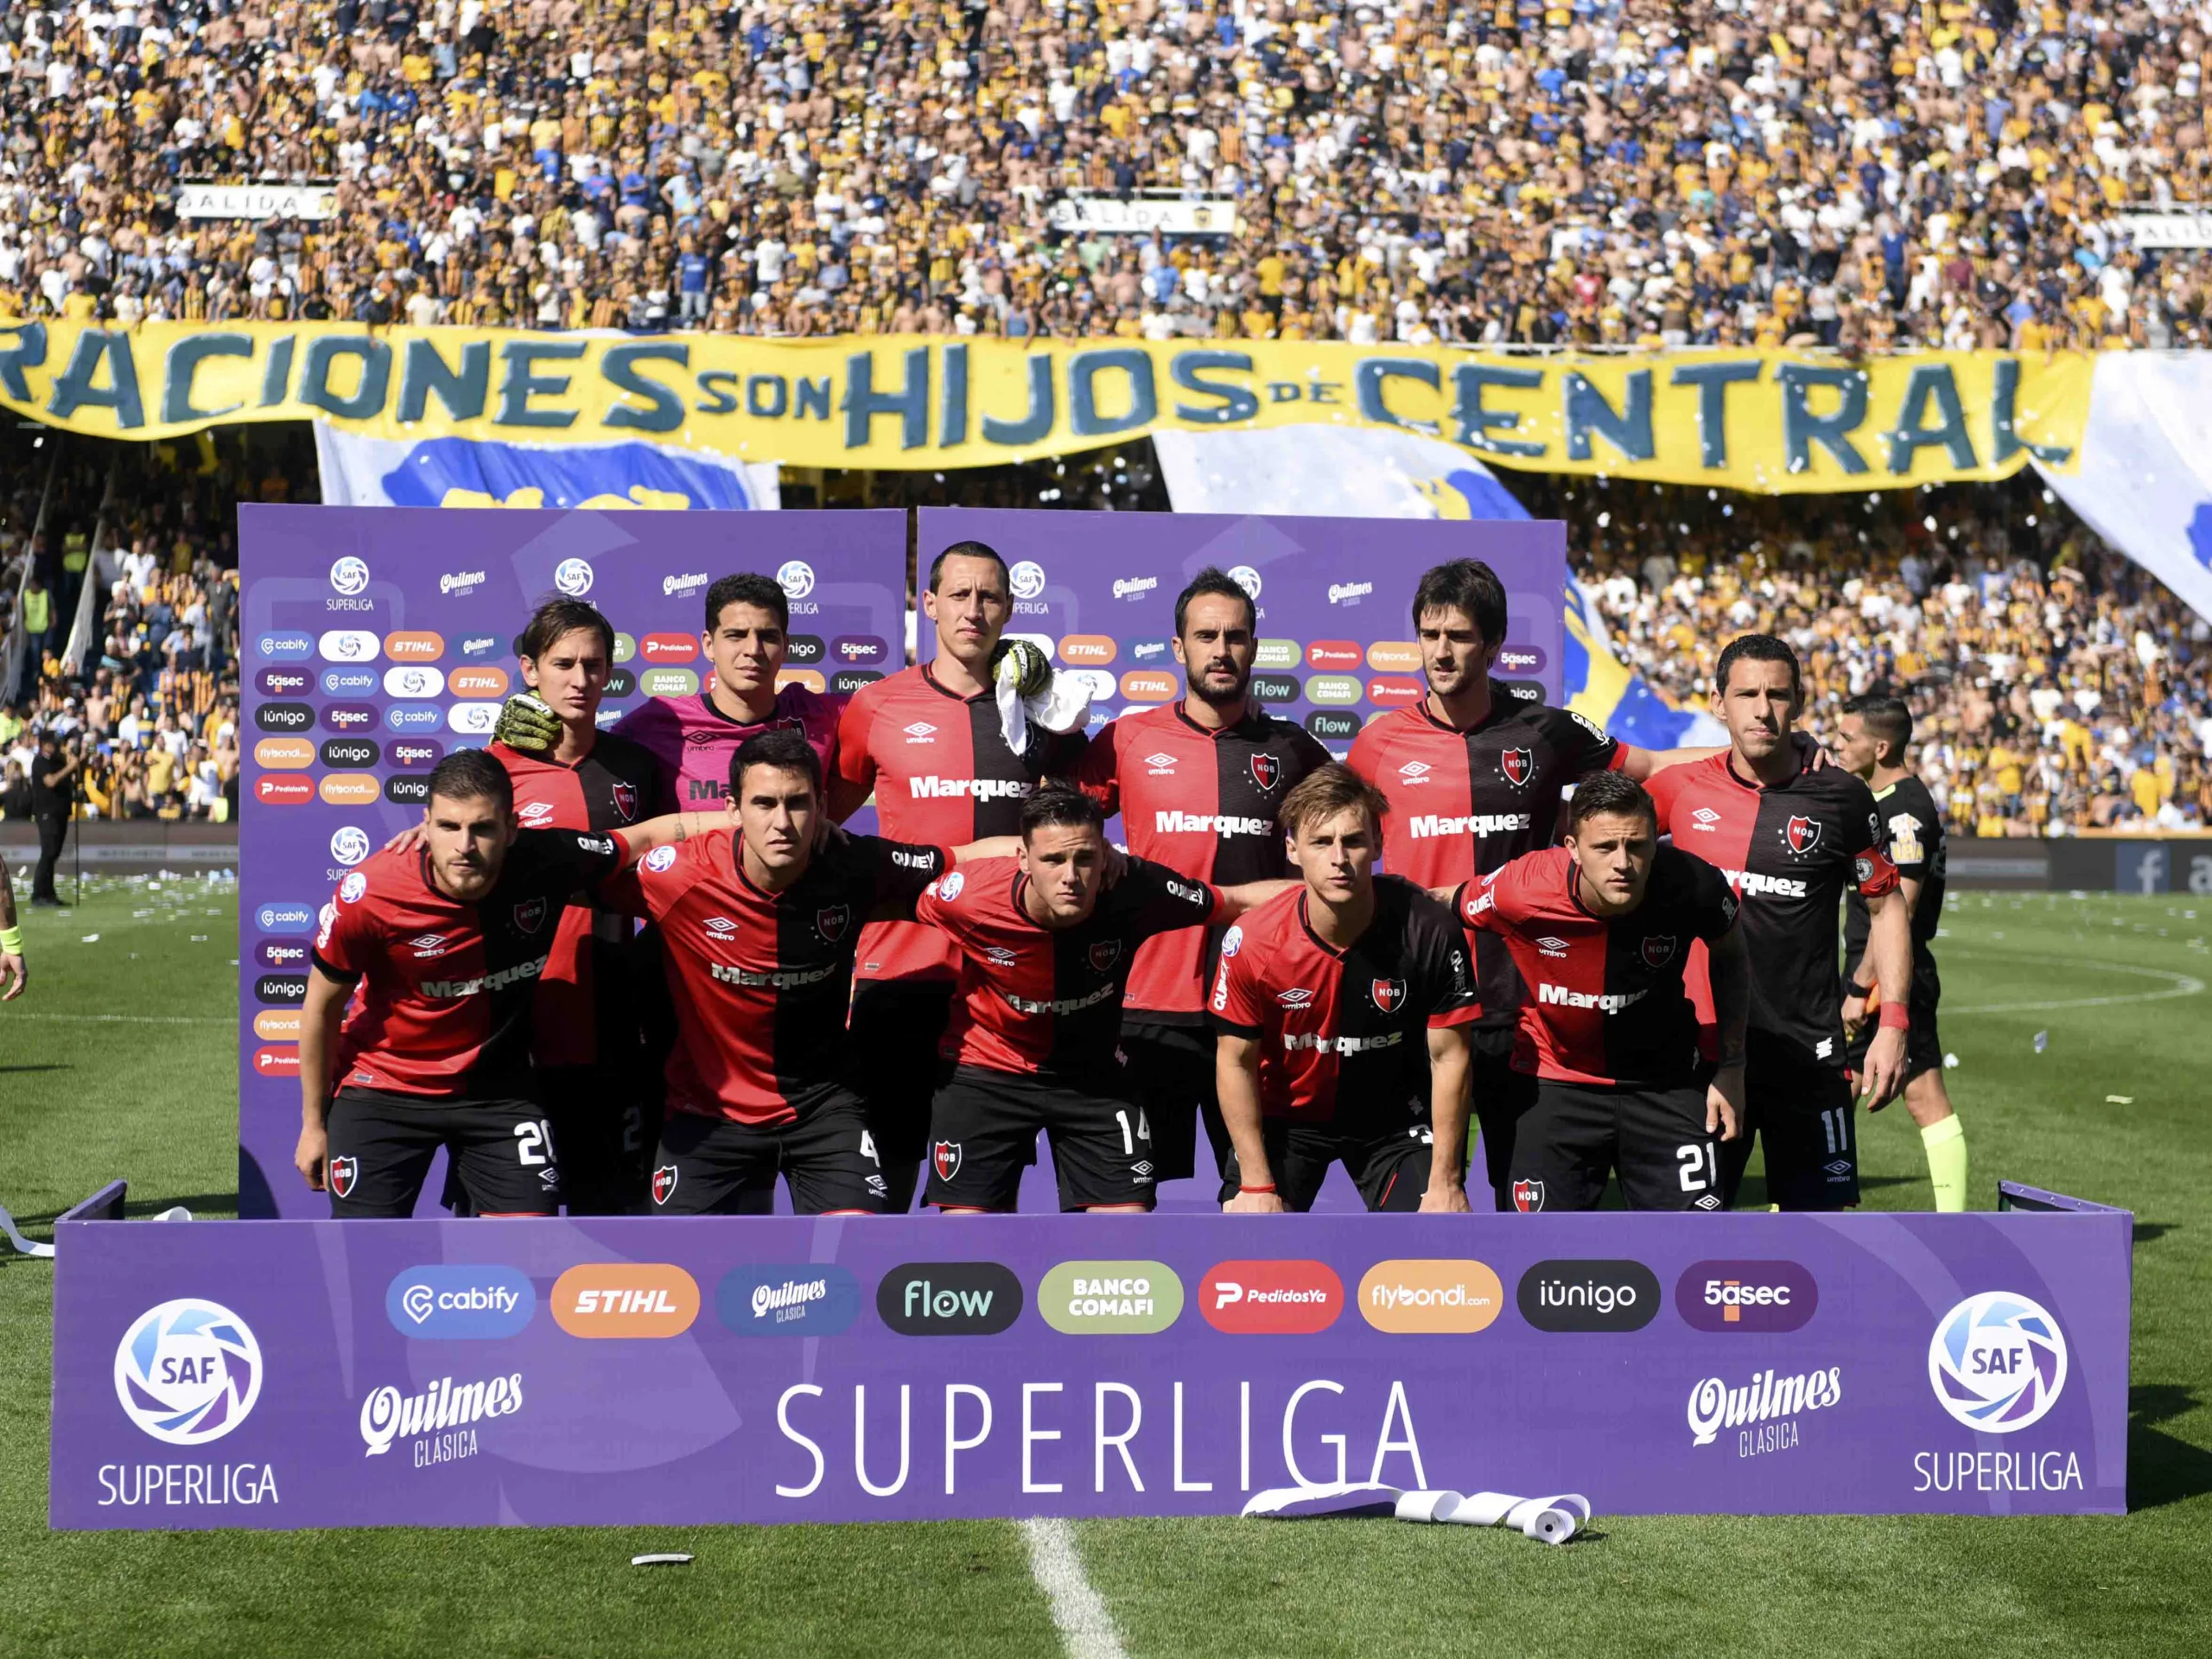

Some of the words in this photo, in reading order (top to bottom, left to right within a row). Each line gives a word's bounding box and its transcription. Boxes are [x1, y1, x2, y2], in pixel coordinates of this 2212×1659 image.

[696, 371, 830, 420] SON
[841, 344, 1260, 451] HIJOS
[1267, 382, 1344, 404] DE
[1355, 356, 2075, 474] CENTRAL
[440, 570, 486, 594] Quilmes
[663, 572, 709, 595] Quilmes
[1112, 576, 1158, 599] Quilmes
[1328, 582, 1373, 604] Quilmes
[327, 599, 373, 611] SUPERLIGA
[787, 602, 819, 614] ERLIGA
[1012, 602, 1049, 614] PERLIGA
[276, 639, 308, 651] cabify
[393, 641, 435, 652] STIHL
[841, 643, 877, 655] 5asec
[1067, 645, 1109, 655] STIHL
[1501, 652, 1537, 664] 5asec
[266, 674, 304, 686] 5asec
[340, 674, 373, 687] cabify
[457, 677, 499, 688] STIHL
[1128, 680, 1169, 692] STIHL
[1254, 680, 1290, 697] flow
[331, 711, 369, 722] 5asec
[404, 709, 437, 723] cabify
[1314, 716, 1351, 734] flow
[1571, 712, 1611, 746] QUIMEX
[396, 747, 433, 758] 5asec
[1257, 764, 1275, 773] NOB
[1402, 776, 1430, 785] umbro
[909, 776, 1033, 802] Marquez
[619, 794, 635, 804] NOB
[524, 816, 553, 827] umbro
[1155, 810, 1274, 838] Marquez
[1410, 813, 1531, 838] Marquez
[1692, 823, 1715, 832] umbro
[1793, 826, 1814, 838] NOB
[1719, 868, 1807, 898] rquez
[276, 911, 308, 924] cabify
[520, 907, 542, 918] NOB
[823, 914, 845, 926] NOB
[706, 931, 734, 941] umbro
[266, 946, 304, 958] 5asec
[414, 947, 445, 958] umbro
[1095, 948, 1116, 958] NOB
[1538, 947, 1567, 958] umbro
[1648, 944, 1670, 955] NOB
[421, 954, 549, 998] Marquez
[1378, 988, 1401, 997] NOB
[1282, 1001, 1311, 1010] umbro
[1284, 1031, 1402, 1057] Marquez
[1116, 1106, 1153, 1154] 14
[1821, 1107, 1847, 1154] 11
[938, 1152, 956, 1163] NOB
[334, 1167, 353, 1179] NOB
[1676, 1141, 1717, 1192] 21
[655, 1175, 672, 1188] NOB
[1518, 1190, 1538, 1202] NOB
[1072, 1278, 1151, 1296] BANCO
[1705, 1281, 1791, 1306] 5asec
[438, 1286, 519, 1313] cabify
[574, 1289, 677, 1313] STIHL
[751, 1279, 826, 1319] Quilmes
[905, 1281, 994, 1318] flow
[1247, 1289, 1327, 1303] PedidosYa
[1372, 1284, 1491, 1310] flybondi.com
[1069, 1299, 1154, 1316] COMAFI
[1972, 1347, 2024, 1374] SAF
[161, 1357, 216, 1384] SAF
[1687, 1366, 1841, 1448] Quilmes
[359, 1372, 523, 1459] Quilmes
[775, 1380, 1428, 1497] SUPERLIGA
[1738, 1421, 1799, 1459] CLÁSICA
[414, 1429, 478, 1469] CLÁSICA
[1913, 1452, 2084, 1492] SUPERLIGA
[98, 1464, 279, 1505] SUPERLIGA
